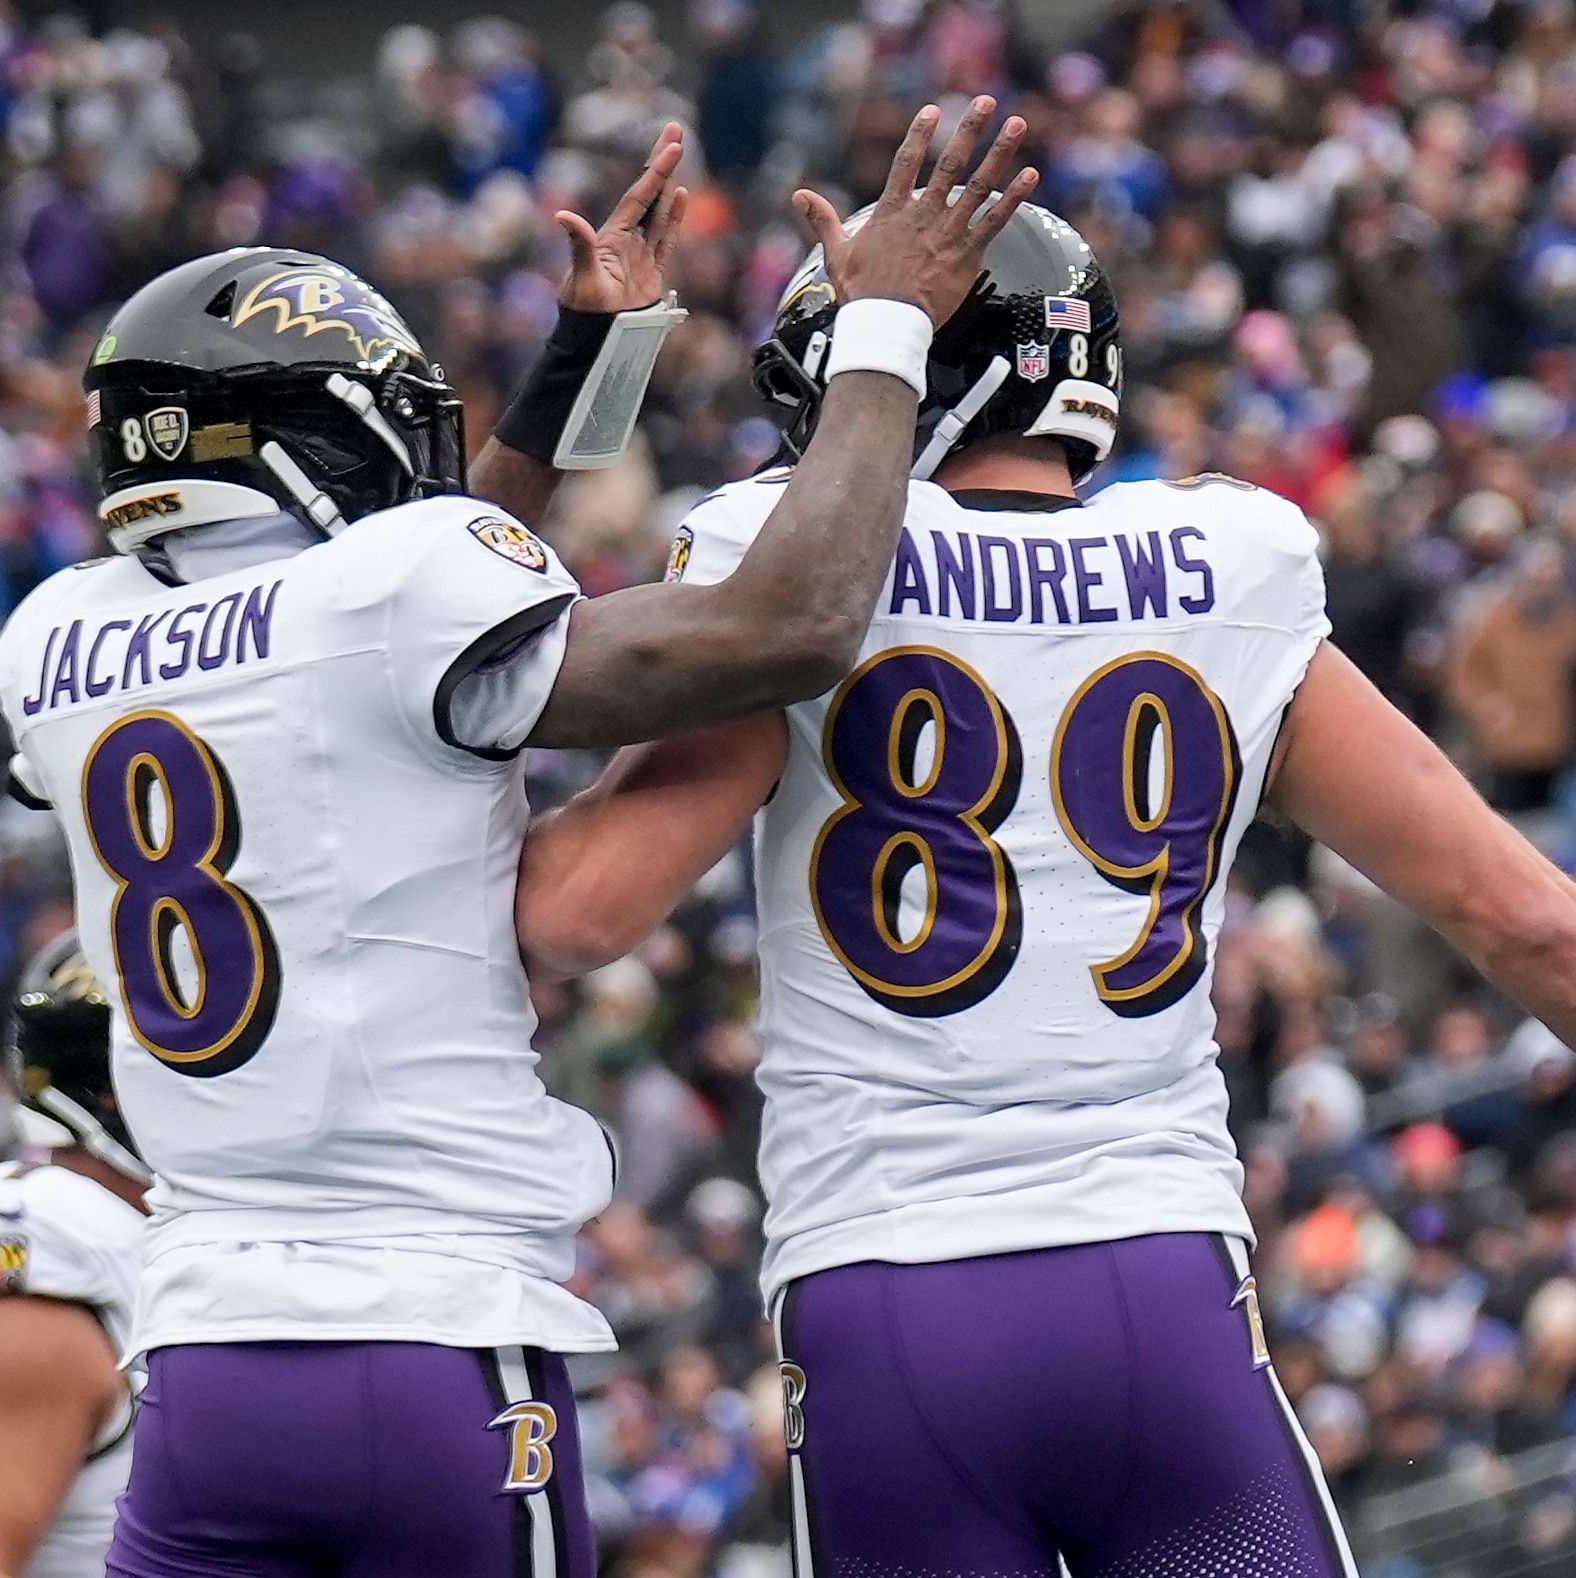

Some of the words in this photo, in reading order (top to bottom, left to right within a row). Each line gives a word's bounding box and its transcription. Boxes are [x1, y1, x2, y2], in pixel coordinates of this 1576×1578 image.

[1023, 359, 1046, 374] NFL
[121, 417, 147, 462] 8
[888, 525, 1215, 625] ANDREWS
[23, 579, 284, 716] JACKSON
[809, 645, 1243, 1018] 89
[81, 709, 284, 1078] 8
[485, 1401, 557, 1489] B
